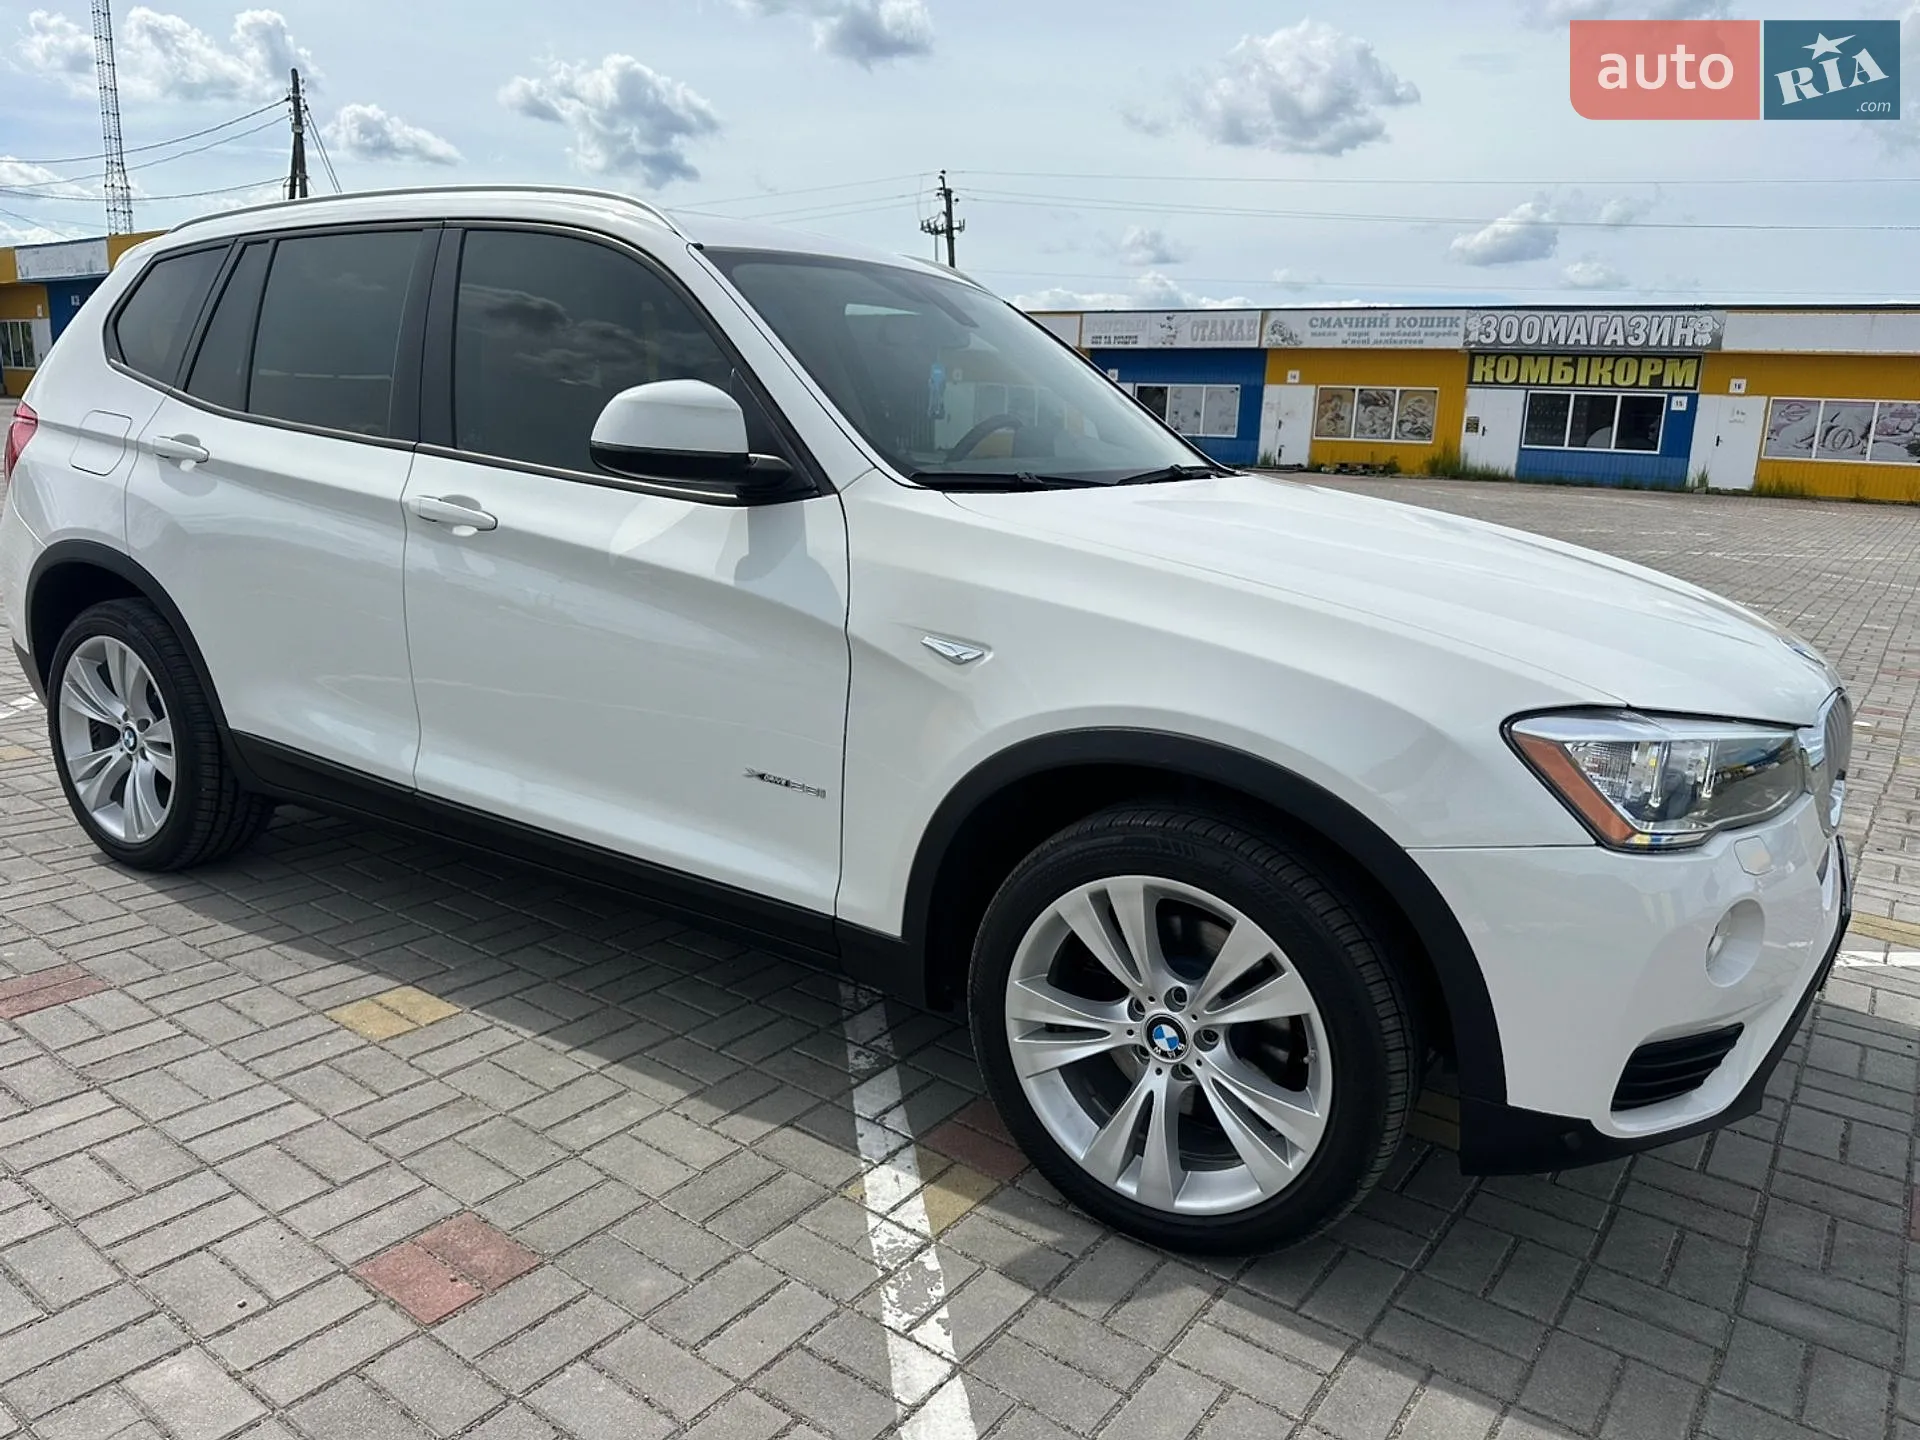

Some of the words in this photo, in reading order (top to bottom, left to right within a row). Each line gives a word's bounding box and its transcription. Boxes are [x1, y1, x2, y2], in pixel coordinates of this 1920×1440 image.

[1190, 319, 1258, 341] ОТАМАН
[1308, 312, 1389, 328] СМАЧНИЙ
[1395, 316, 1460, 328] КОШИК
[1479, 314, 1695, 347] ЗООМАГАЗИН
[1472, 355, 1699, 388] КОМБІКОРМ
